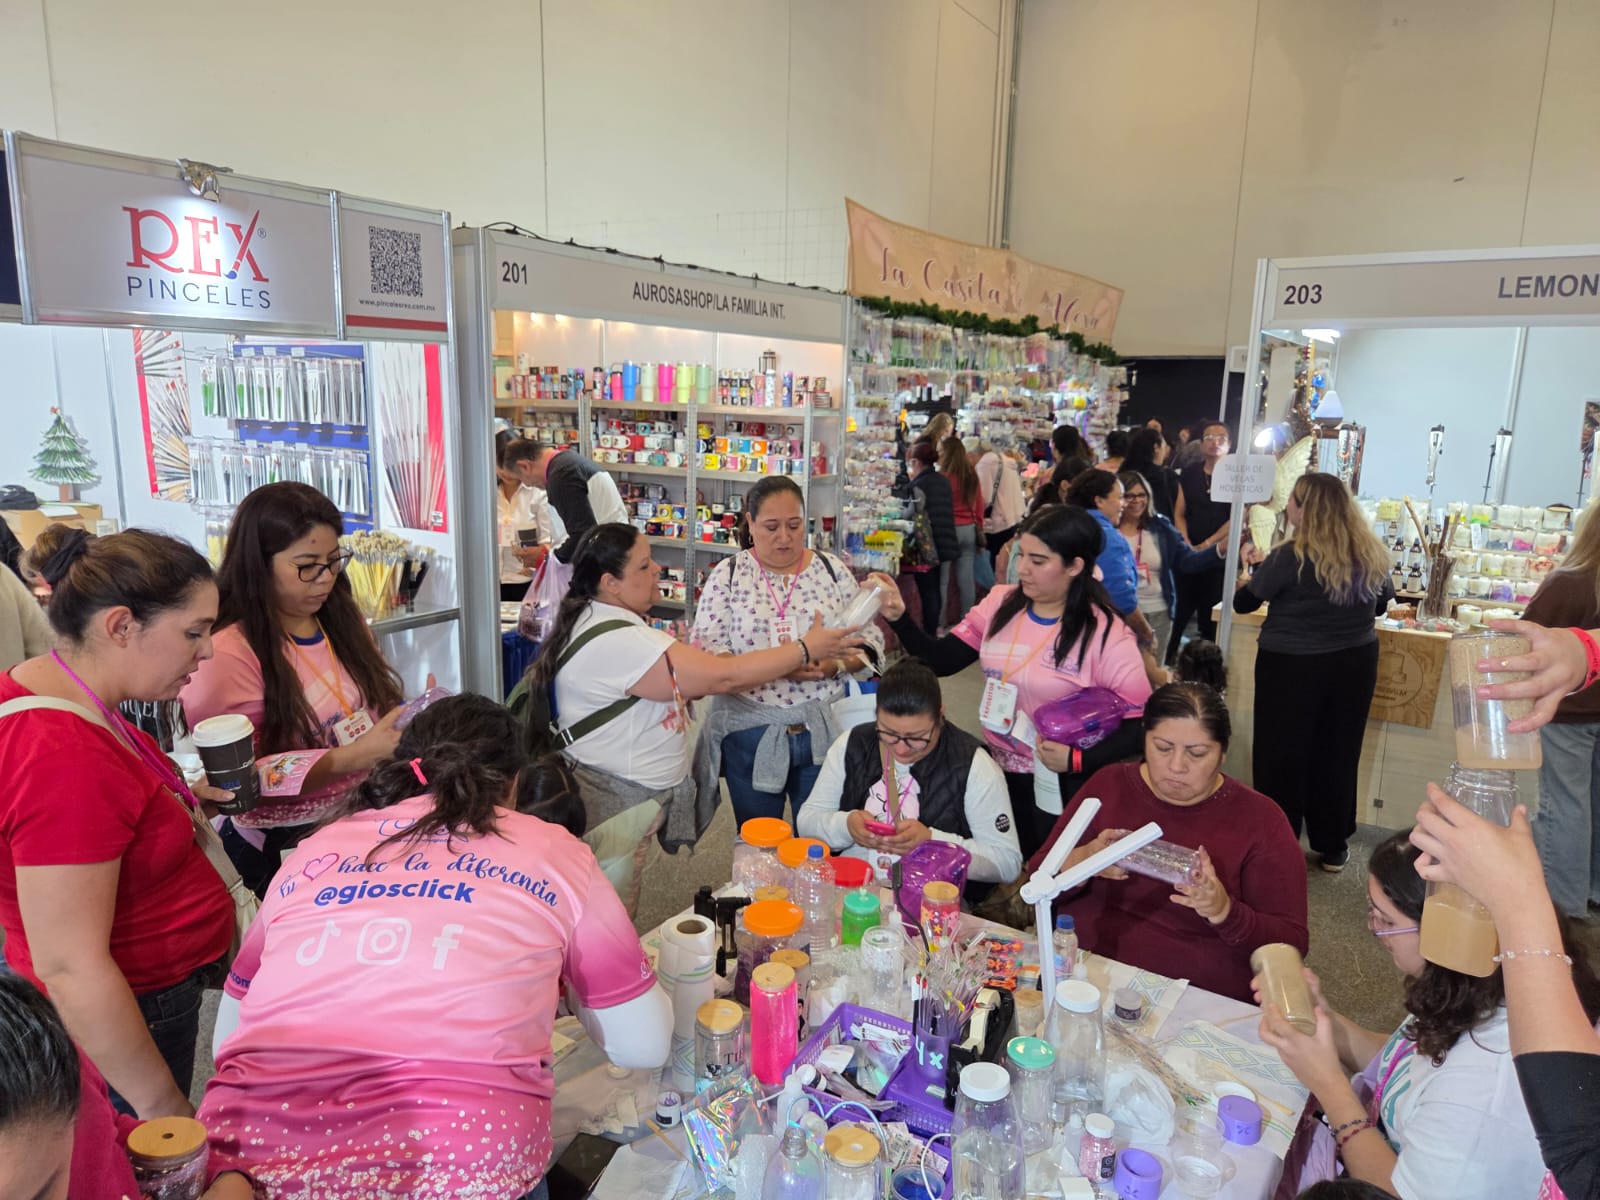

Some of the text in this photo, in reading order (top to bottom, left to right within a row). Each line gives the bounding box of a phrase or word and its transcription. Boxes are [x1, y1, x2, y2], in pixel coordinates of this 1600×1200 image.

[502, 261, 528, 285] 201
[1497, 273, 1600, 299] LEMON
[127, 276, 271, 309] PINCELES
[1284, 284, 1323, 305] 203
[731, 296, 768, 318] FAMILIA
[314, 878, 476, 906] @giosclick
[405, 852, 432, 871] la
[447, 853, 557, 906] diferencia
